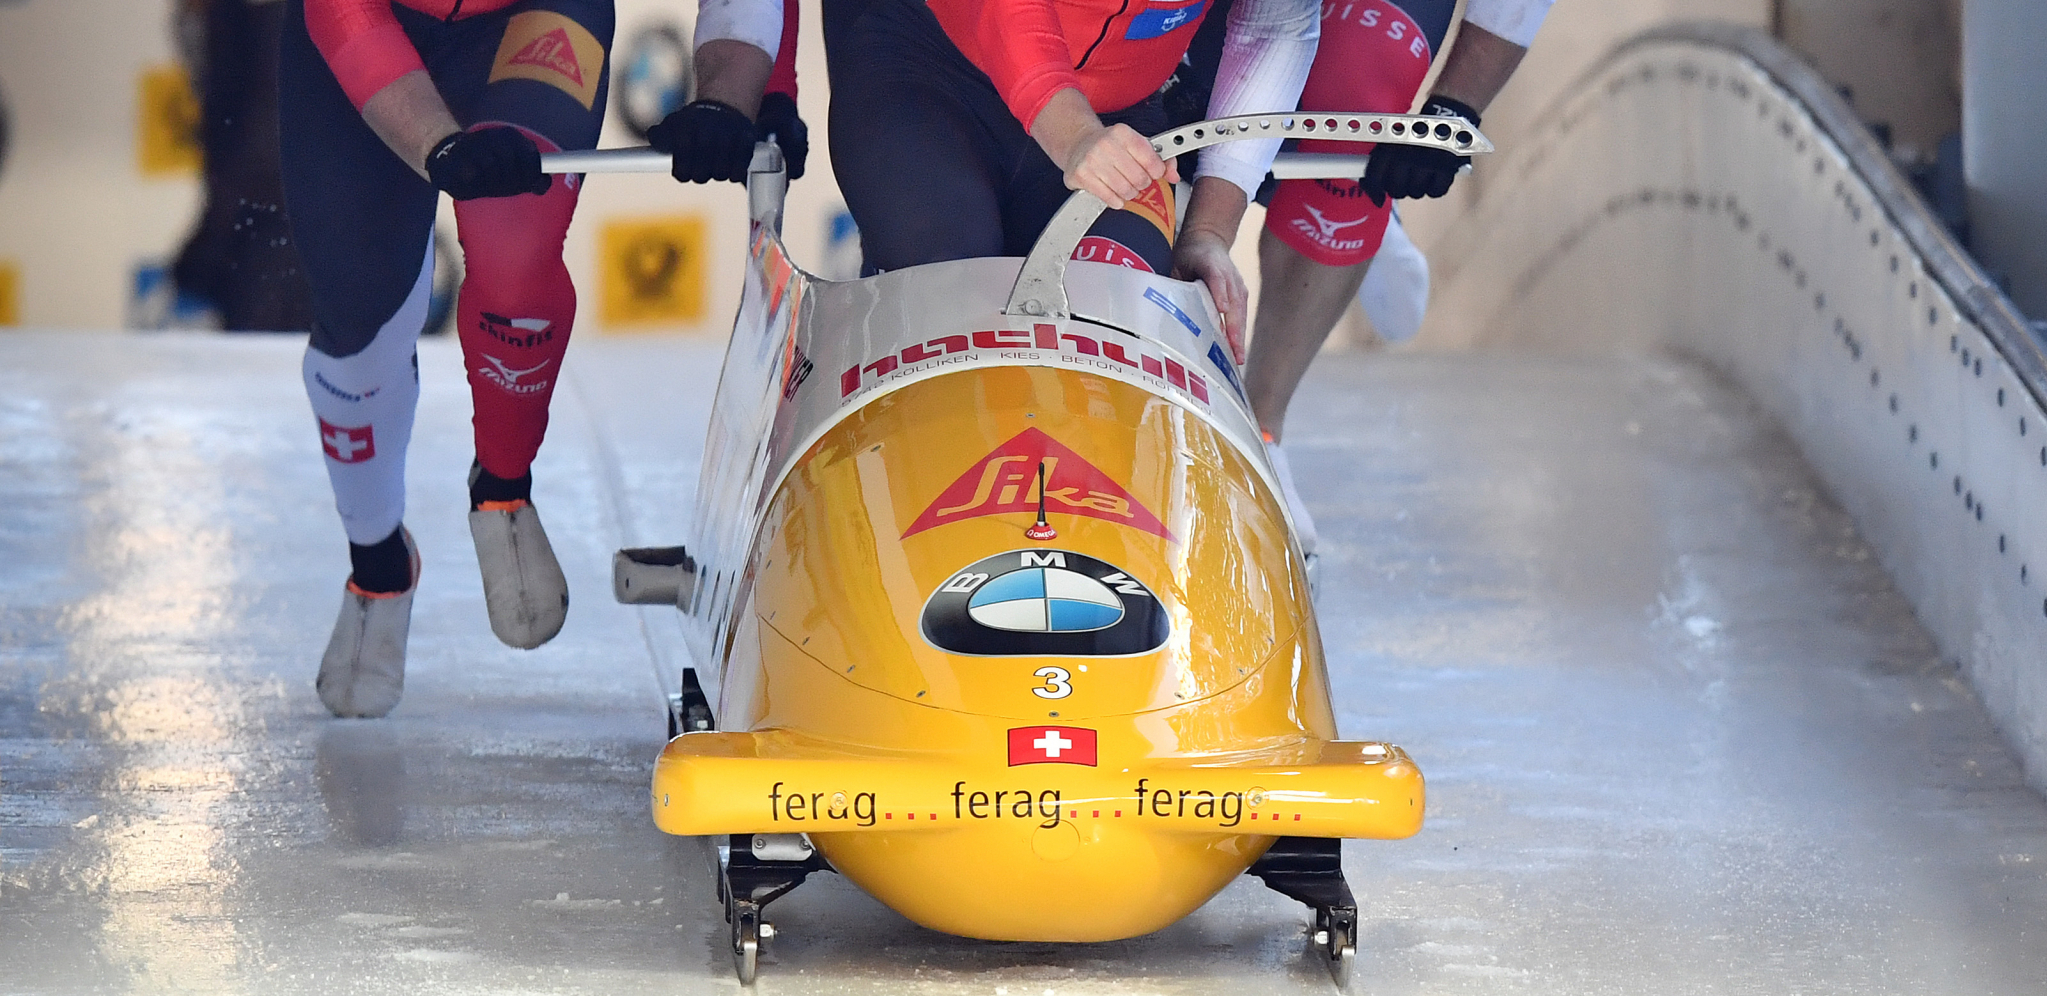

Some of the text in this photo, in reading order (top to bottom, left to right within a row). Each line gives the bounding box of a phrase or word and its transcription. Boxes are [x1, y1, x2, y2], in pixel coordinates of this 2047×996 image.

[1322, 3, 1425, 58] UISSE
[1000, 351, 1040, 361] KIES
[1061, 354, 1122, 374] BETON
[936, 455, 1134, 517] Sika
[941, 551, 1150, 597] BMW
[1032, 666, 1073, 700] 3
